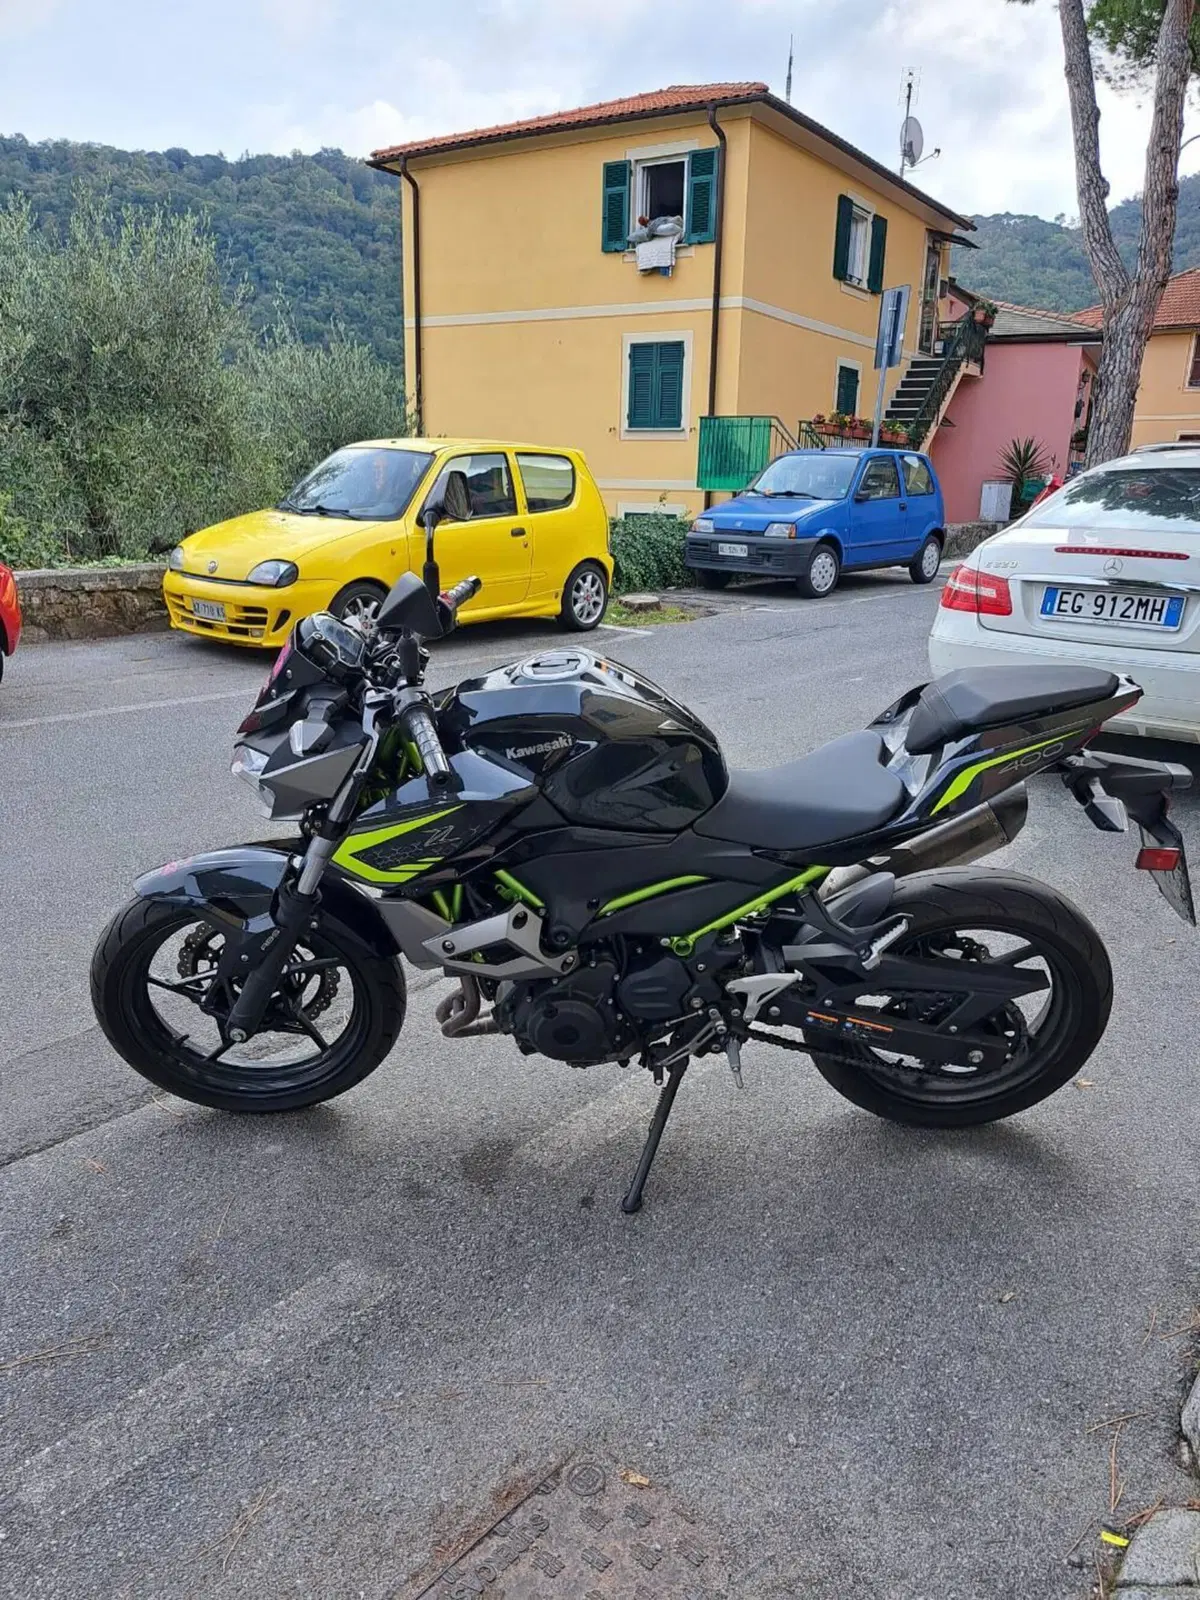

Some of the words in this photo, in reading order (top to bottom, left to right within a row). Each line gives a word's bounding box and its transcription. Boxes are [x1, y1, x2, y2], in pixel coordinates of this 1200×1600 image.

[1056, 591, 1085, 614] EG
[1092, 594, 1166, 622] 912MH
[505, 734, 574, 760] Kawasaki
[998, 742, 1064, 775] 400
